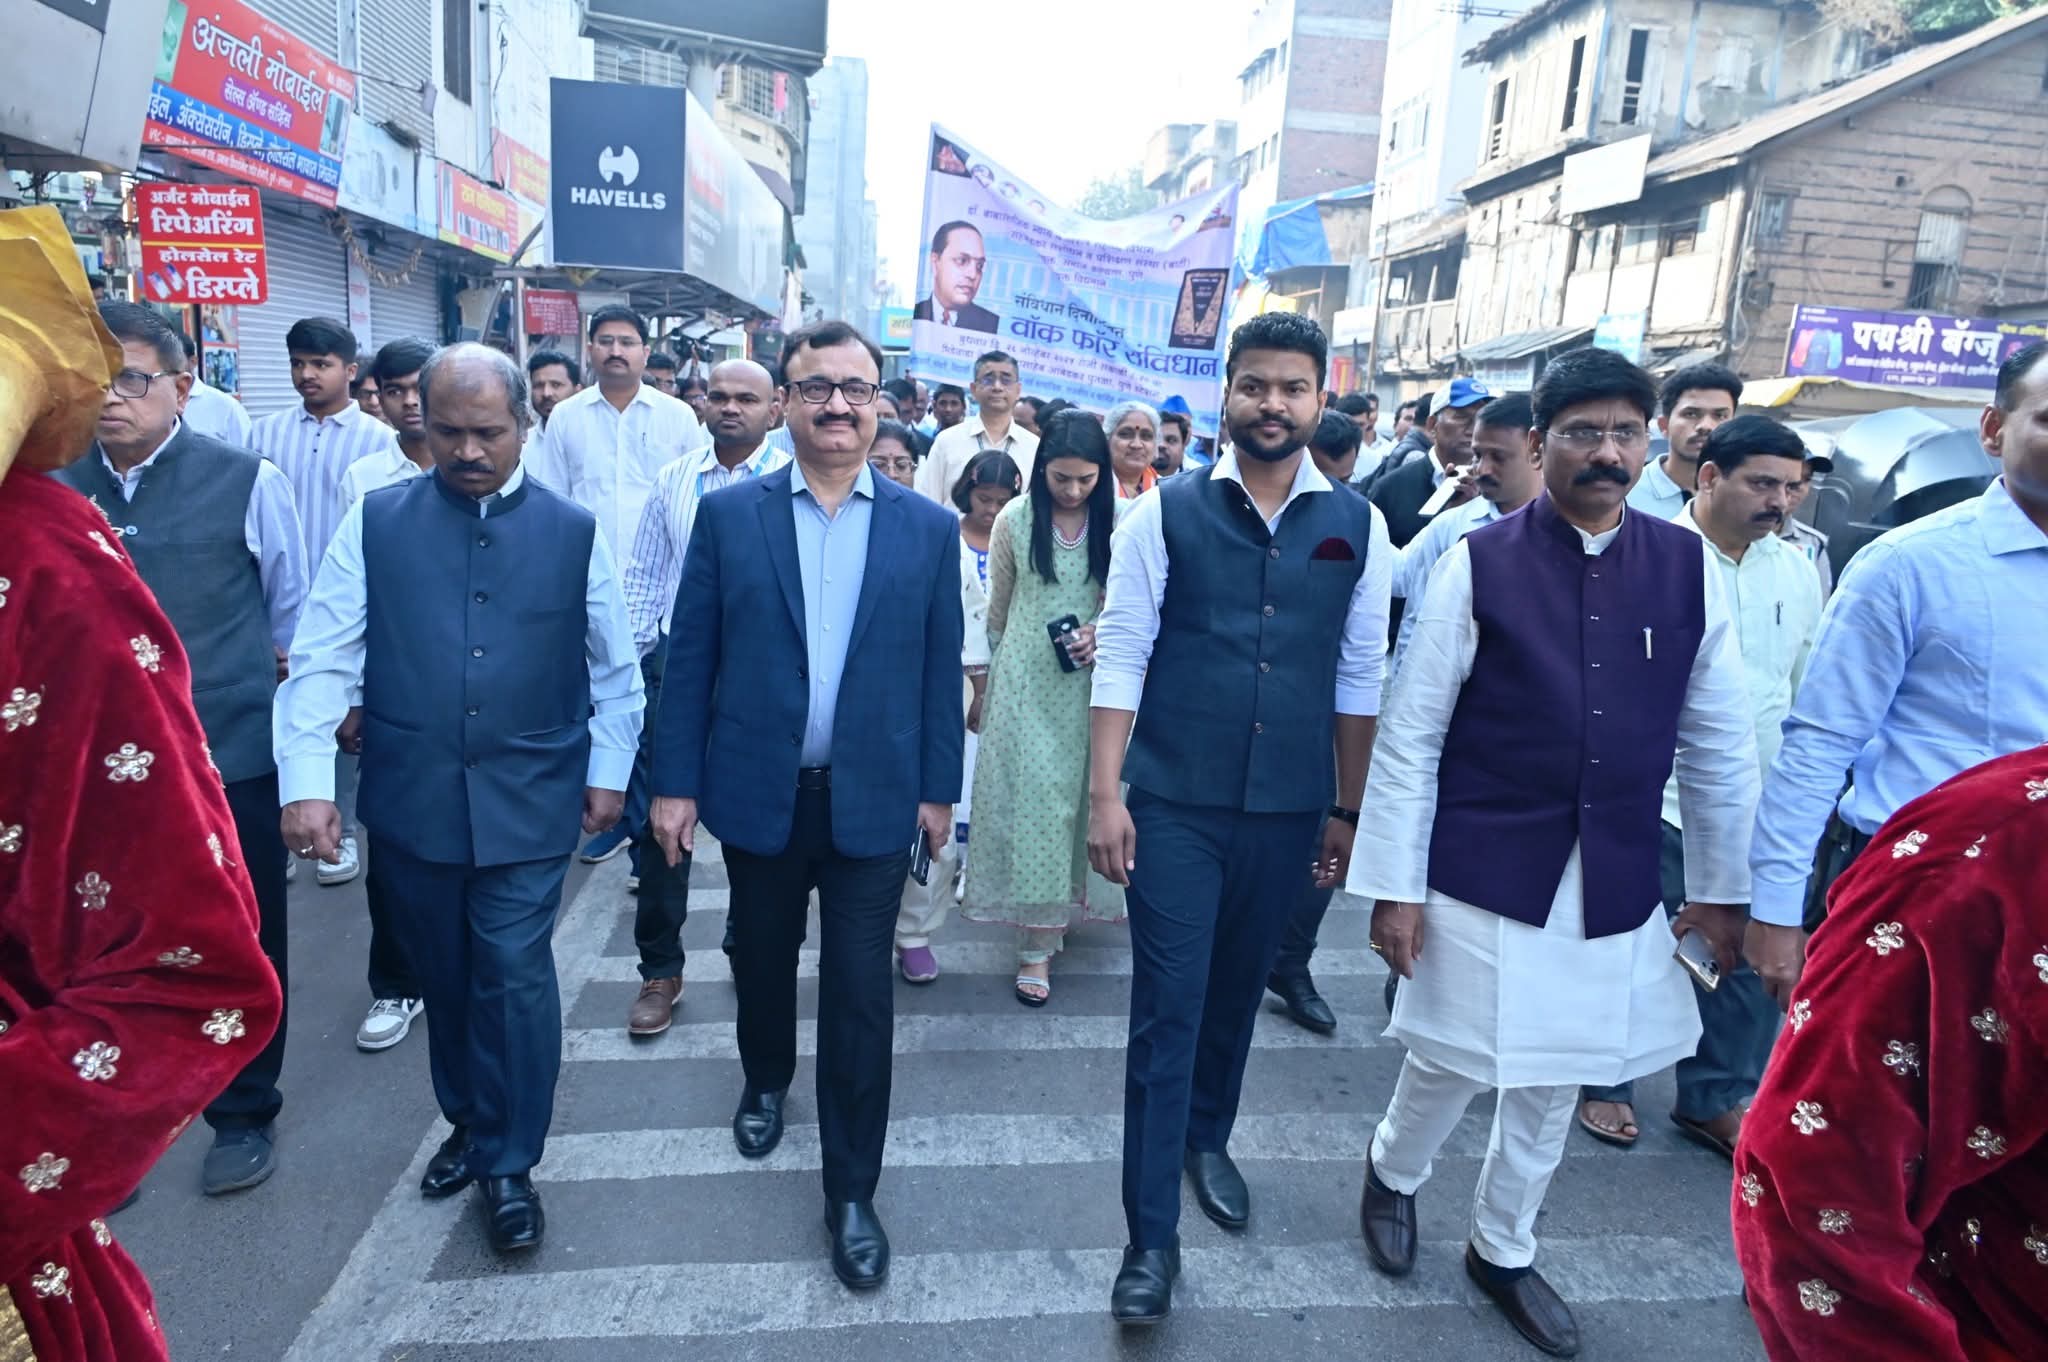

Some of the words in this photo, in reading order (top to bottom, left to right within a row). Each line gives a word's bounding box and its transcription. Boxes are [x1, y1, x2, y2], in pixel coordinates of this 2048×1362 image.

[193, 14, 264, 80] अंजली
[265, 50, 326, 114] मोबाईल
[190, 187, 250, 208] मोबाईल
[570, 186, 668, 210] HAVELLS
[150, 206, 255, 236] रिपेअरिंग
[159, 245, 228, 263] होलसेल
[233, 247, 257, 263] रेट
[185, 266, 260, 300] डिस्प्ले
[1010, 315, 1067, 344] वॉक
[1071, 328, 1121, 358] फॉर
[1125, 342, 1220, 378] संविधान
